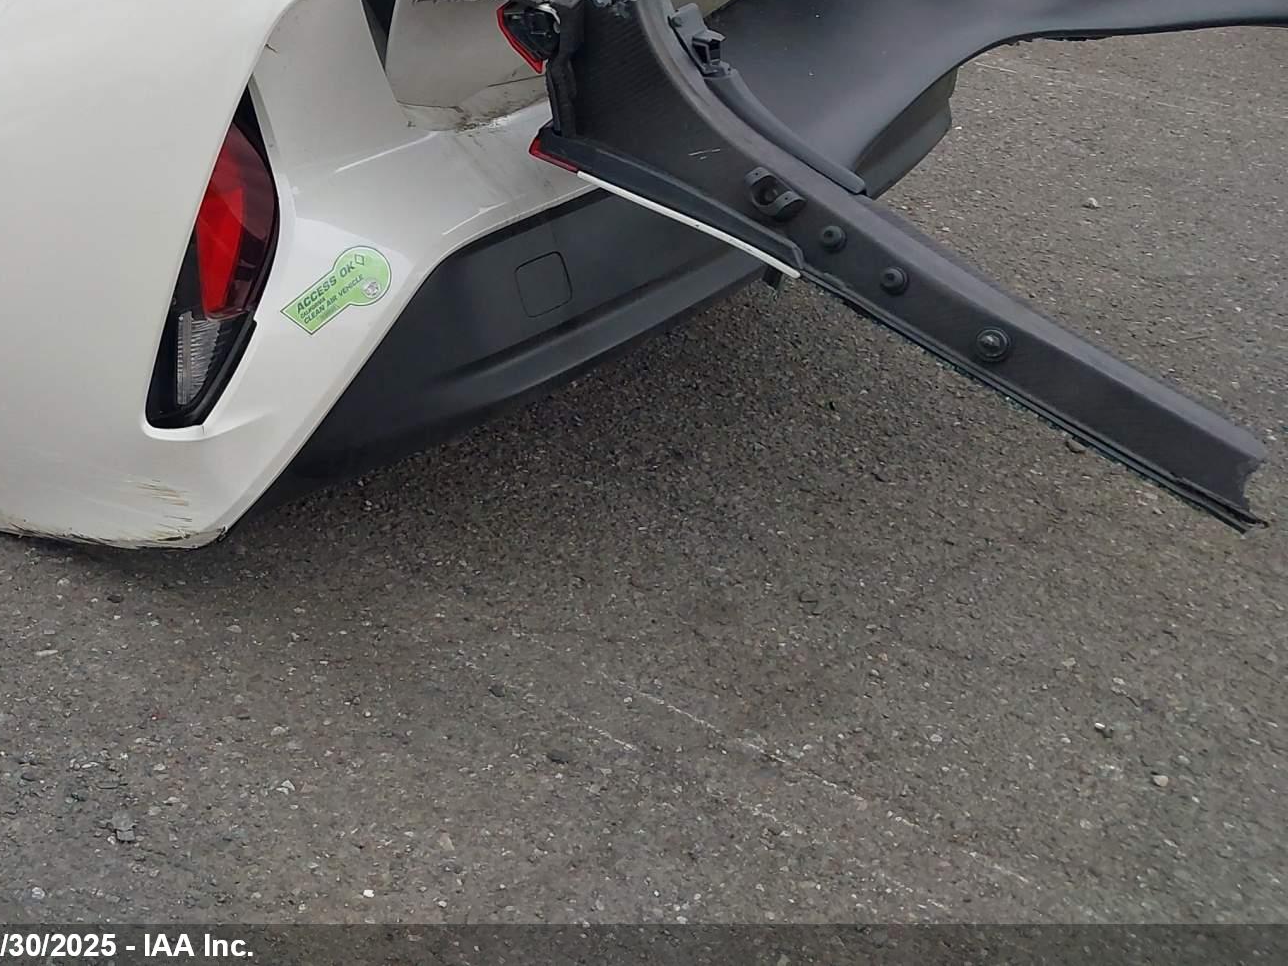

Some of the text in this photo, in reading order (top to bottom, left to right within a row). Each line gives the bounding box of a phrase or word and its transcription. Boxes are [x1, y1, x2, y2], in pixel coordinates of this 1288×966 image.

[296, 275, 337, 314] ACCESS
[339, 261, 355, 278] OK
[304, 306, 326, 324] CLEAN
[326, 296, 338, 308] AIR
[338, 274, 364, 297] VEHICLE
